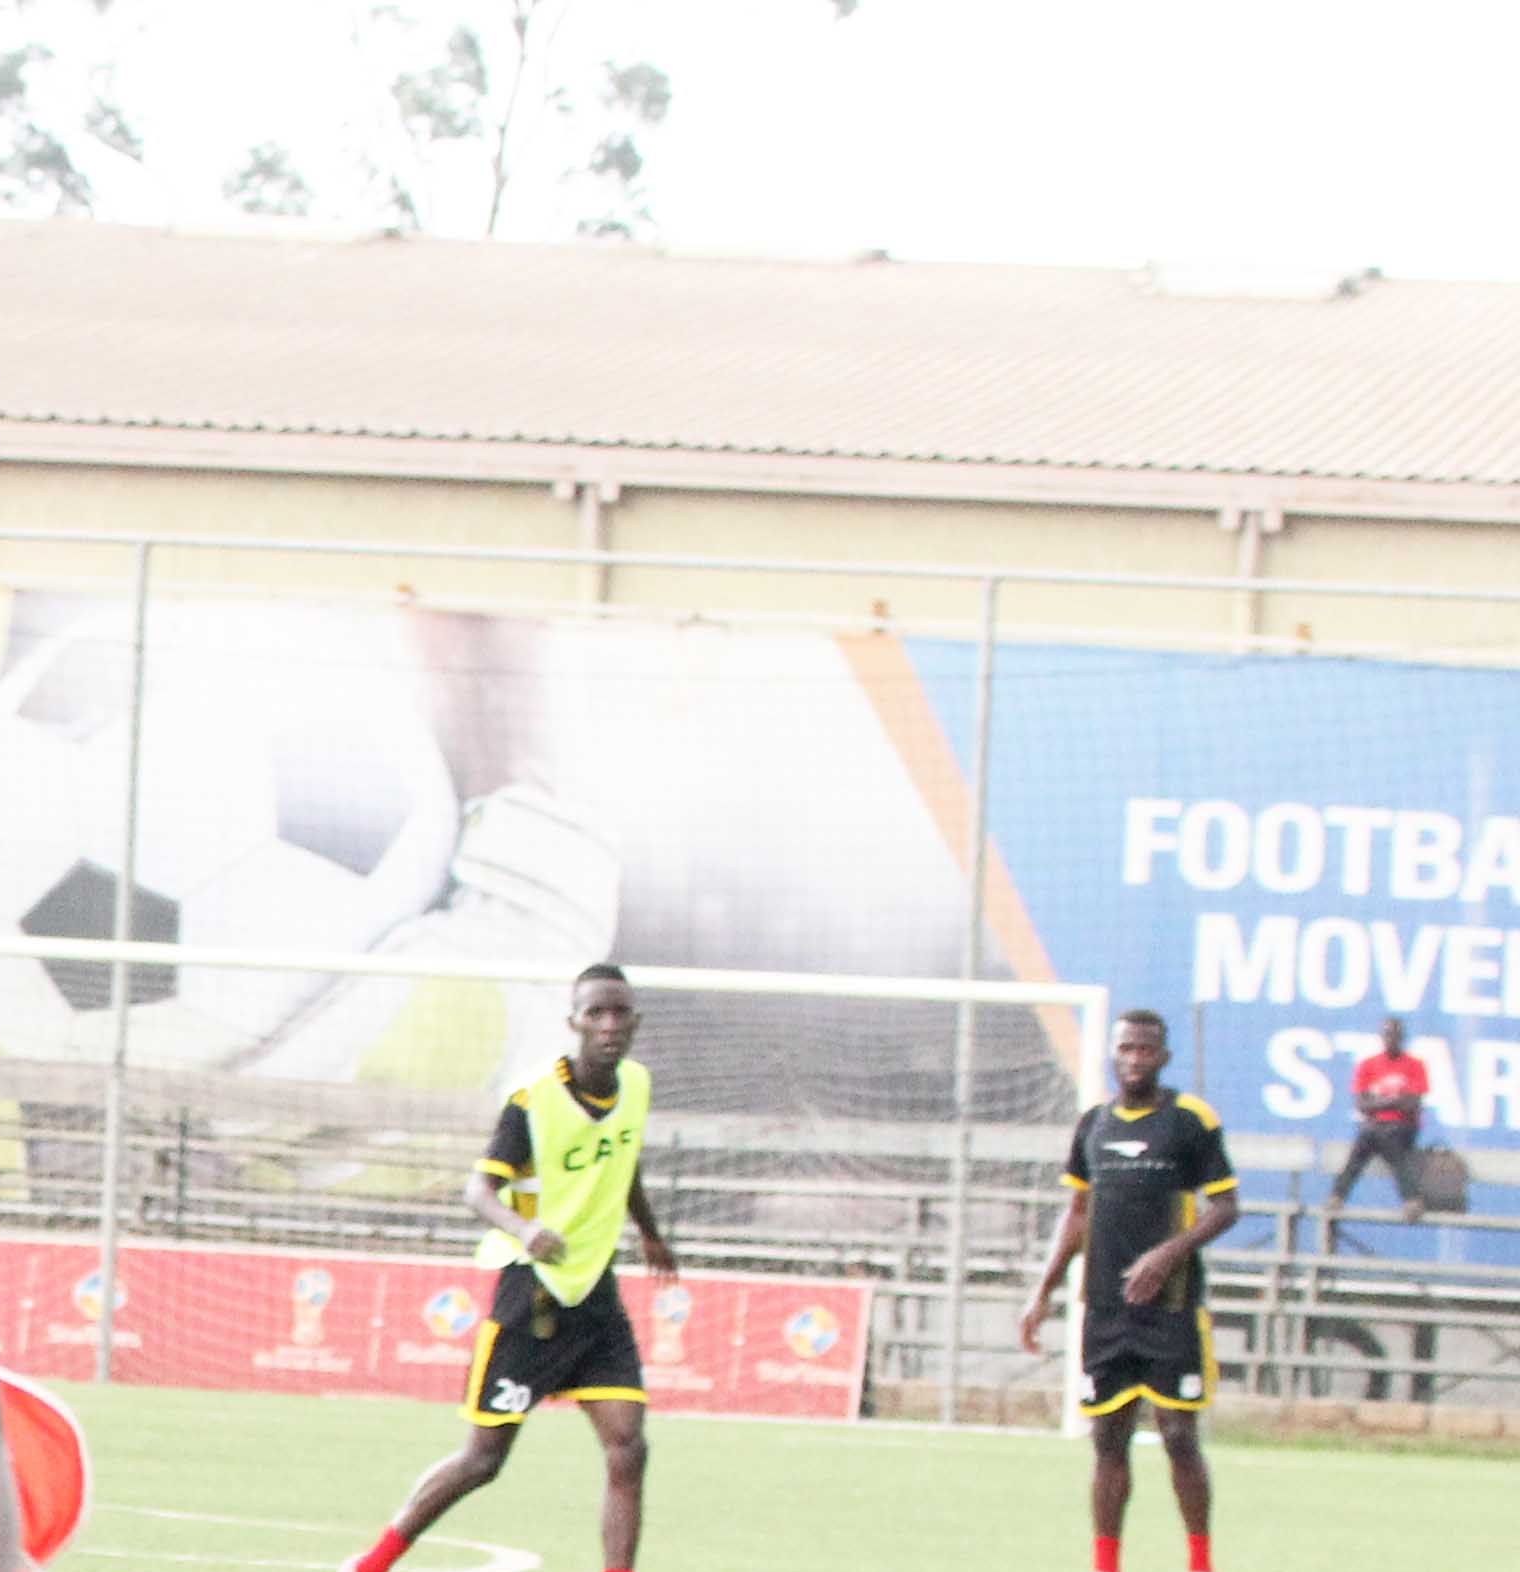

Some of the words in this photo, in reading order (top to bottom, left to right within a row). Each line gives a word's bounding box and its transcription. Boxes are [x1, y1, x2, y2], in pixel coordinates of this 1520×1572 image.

[1122, 798, 1520, 905] FOOTBA
[1193, 911, 1520, 1018] MOVE
[490, 1378, 532, 1412] 20
